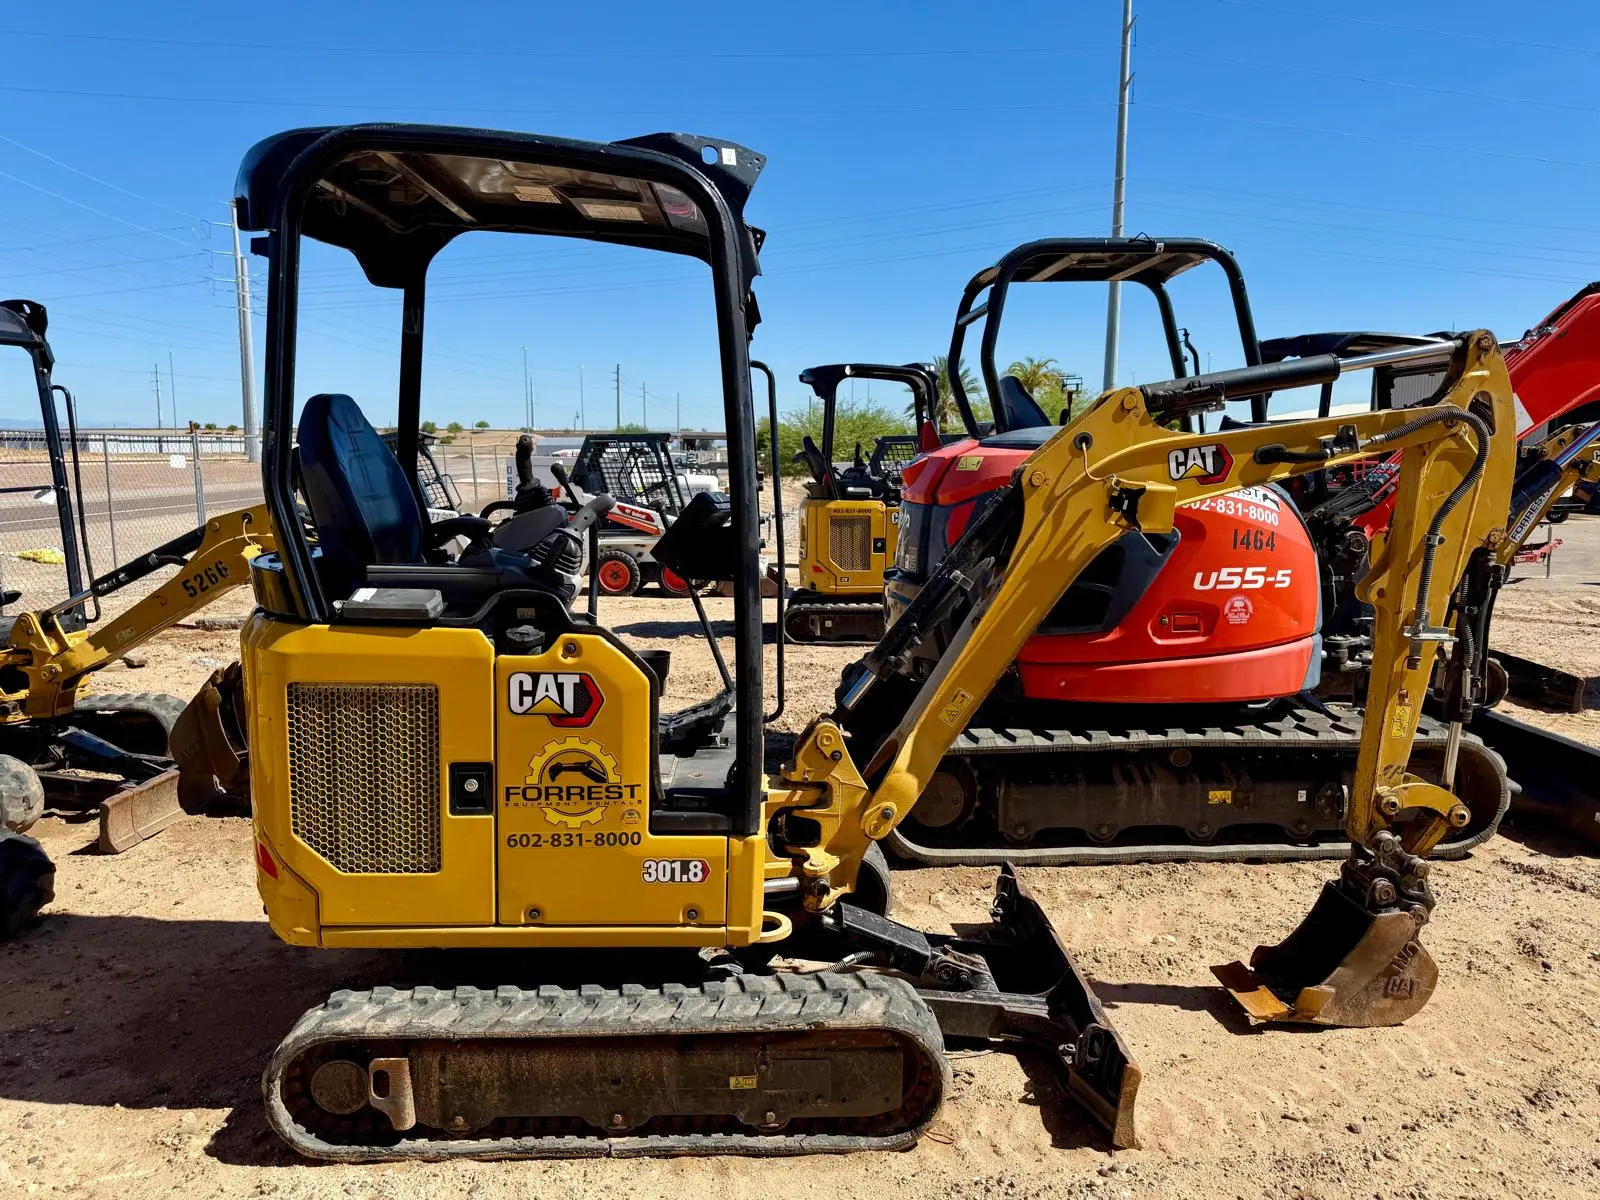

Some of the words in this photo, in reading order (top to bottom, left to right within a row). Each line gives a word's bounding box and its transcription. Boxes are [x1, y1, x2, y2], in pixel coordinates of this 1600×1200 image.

[1168, 445, 1216, 480] CAT
[1232, 528, 1276, 552] 1464
[181, 560, 229, 598] 5266
[509, 673, 580, 715] CAT
[505, 784, 642, 802] FORREST
[506, 832, 642, 848] 602-831-8000
[643, 859, 703, 883] 301.8
